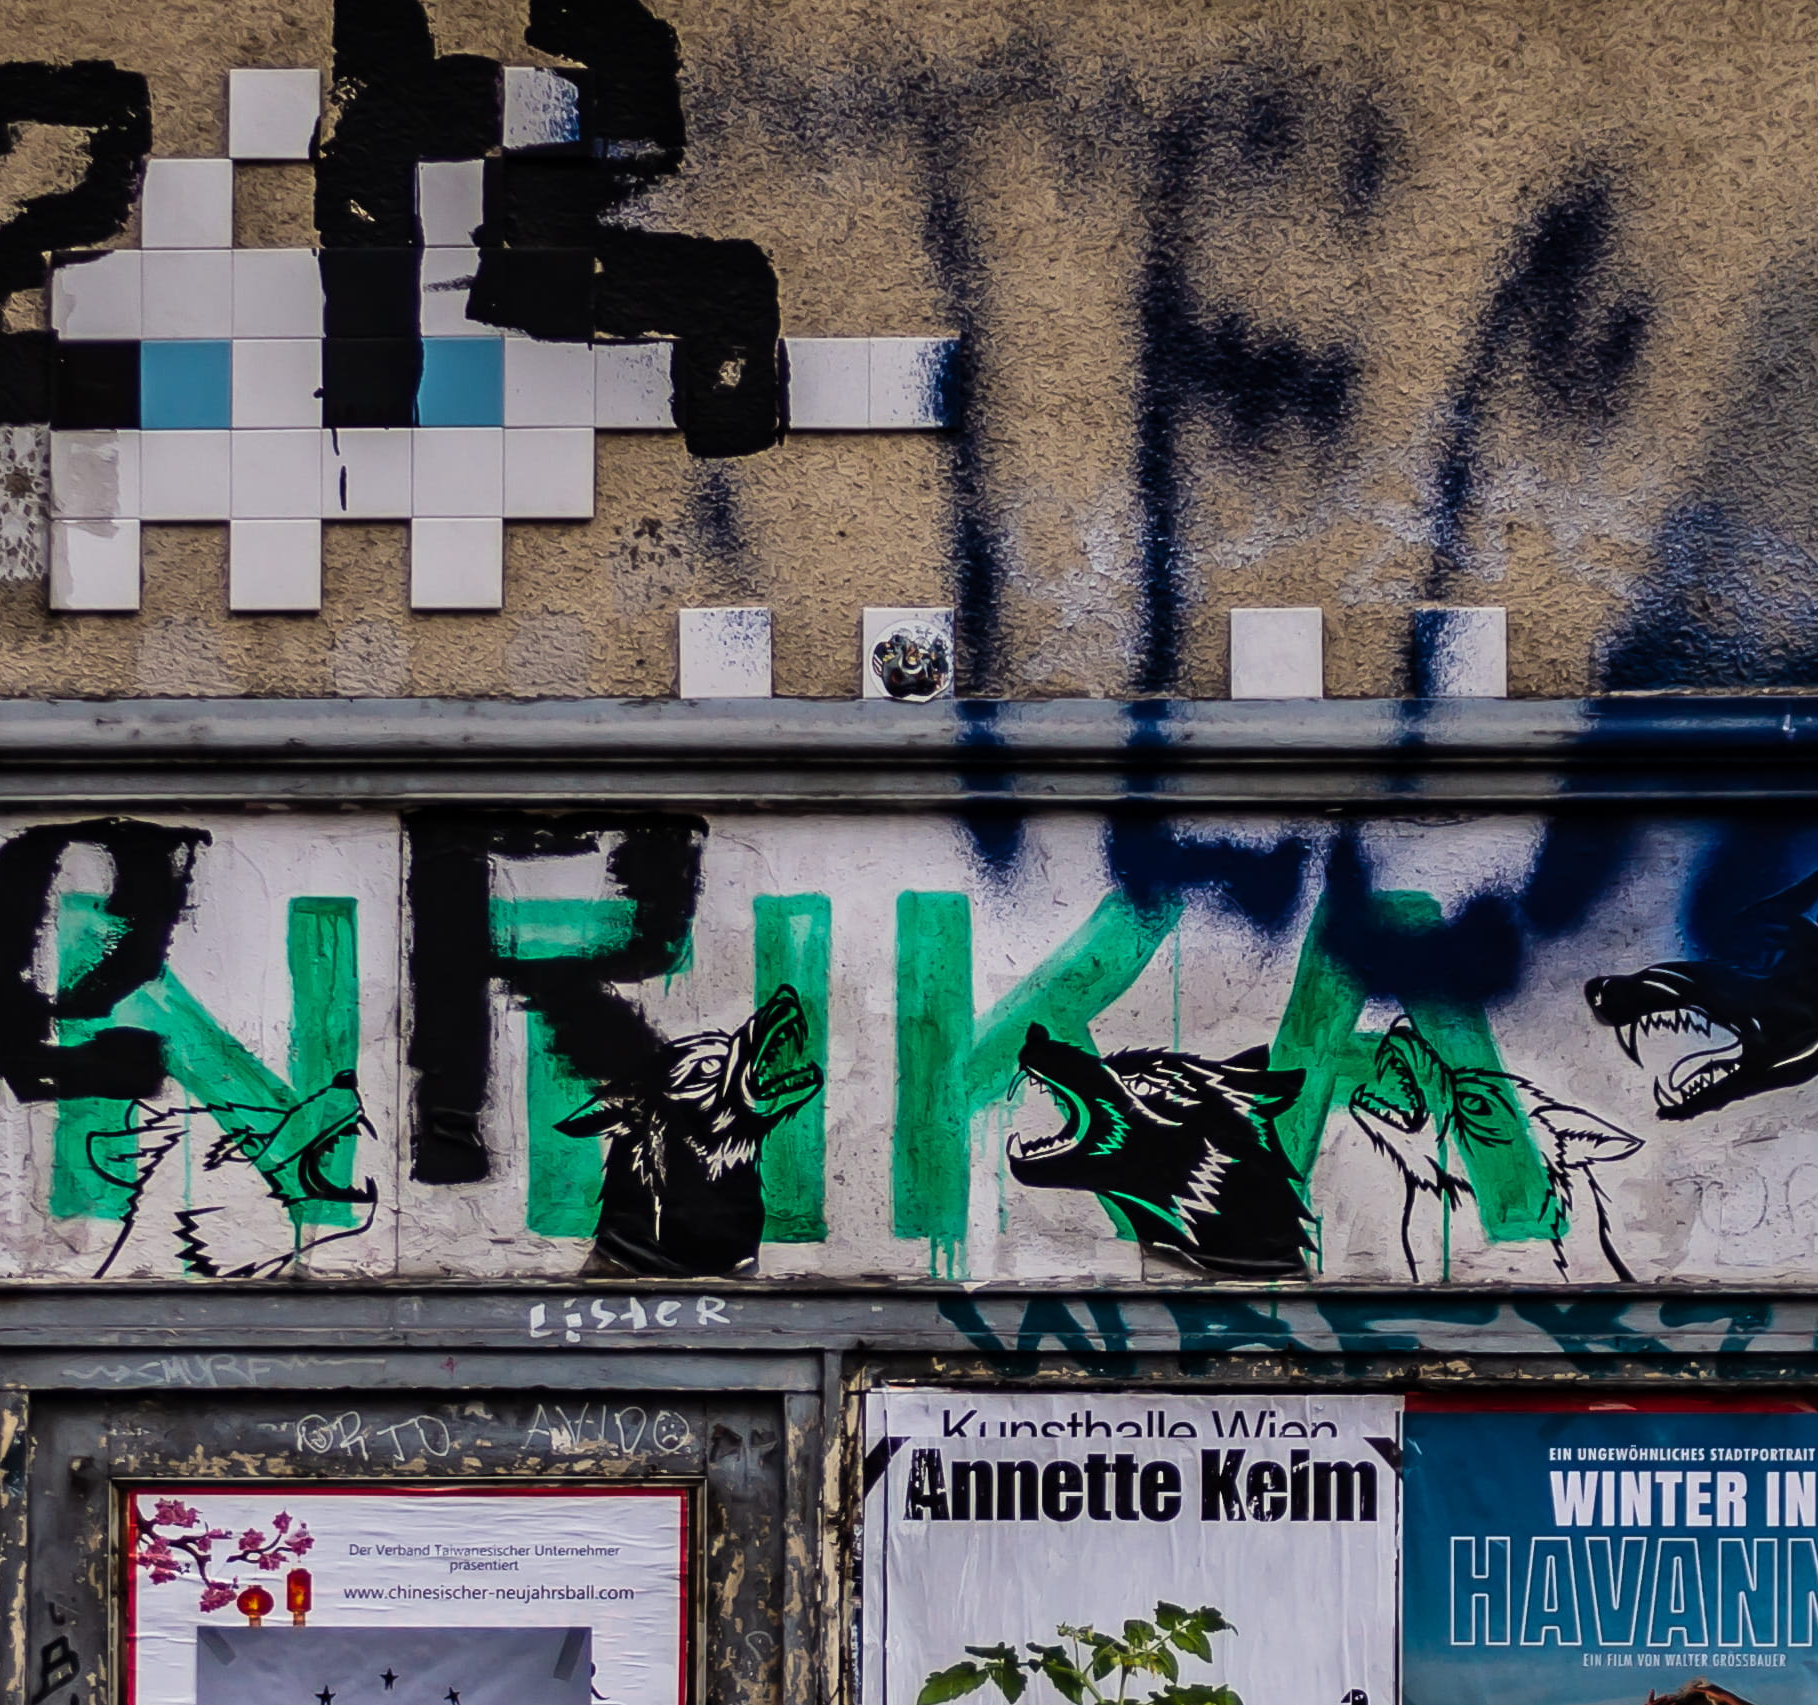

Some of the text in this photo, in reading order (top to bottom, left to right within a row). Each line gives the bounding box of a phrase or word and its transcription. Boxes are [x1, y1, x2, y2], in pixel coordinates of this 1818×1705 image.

[1549, 1445, 1816, 1462] EIN UNGEWÖHNLICHES STADTPORTRAIT
[903, 1448, 1182, 1522] Annette
[1549, 1470, 1817, 1527] WINTER IN
[349, 1544, 621, 1557] Der Verband Taiwanesischer Unternehmer
[449, 1560, 519, 1573] präsentiert
[344, 1584, 635, 1604] www.chinesischer-neujahrsball.com
[1583, 1654, 1603, 1667] EIN
[1606, 1654, 1633, 1667] FILM
[1637, 1654, 1661, 1667] VON
[1665, 1654, 1709, 1667] WALTER
